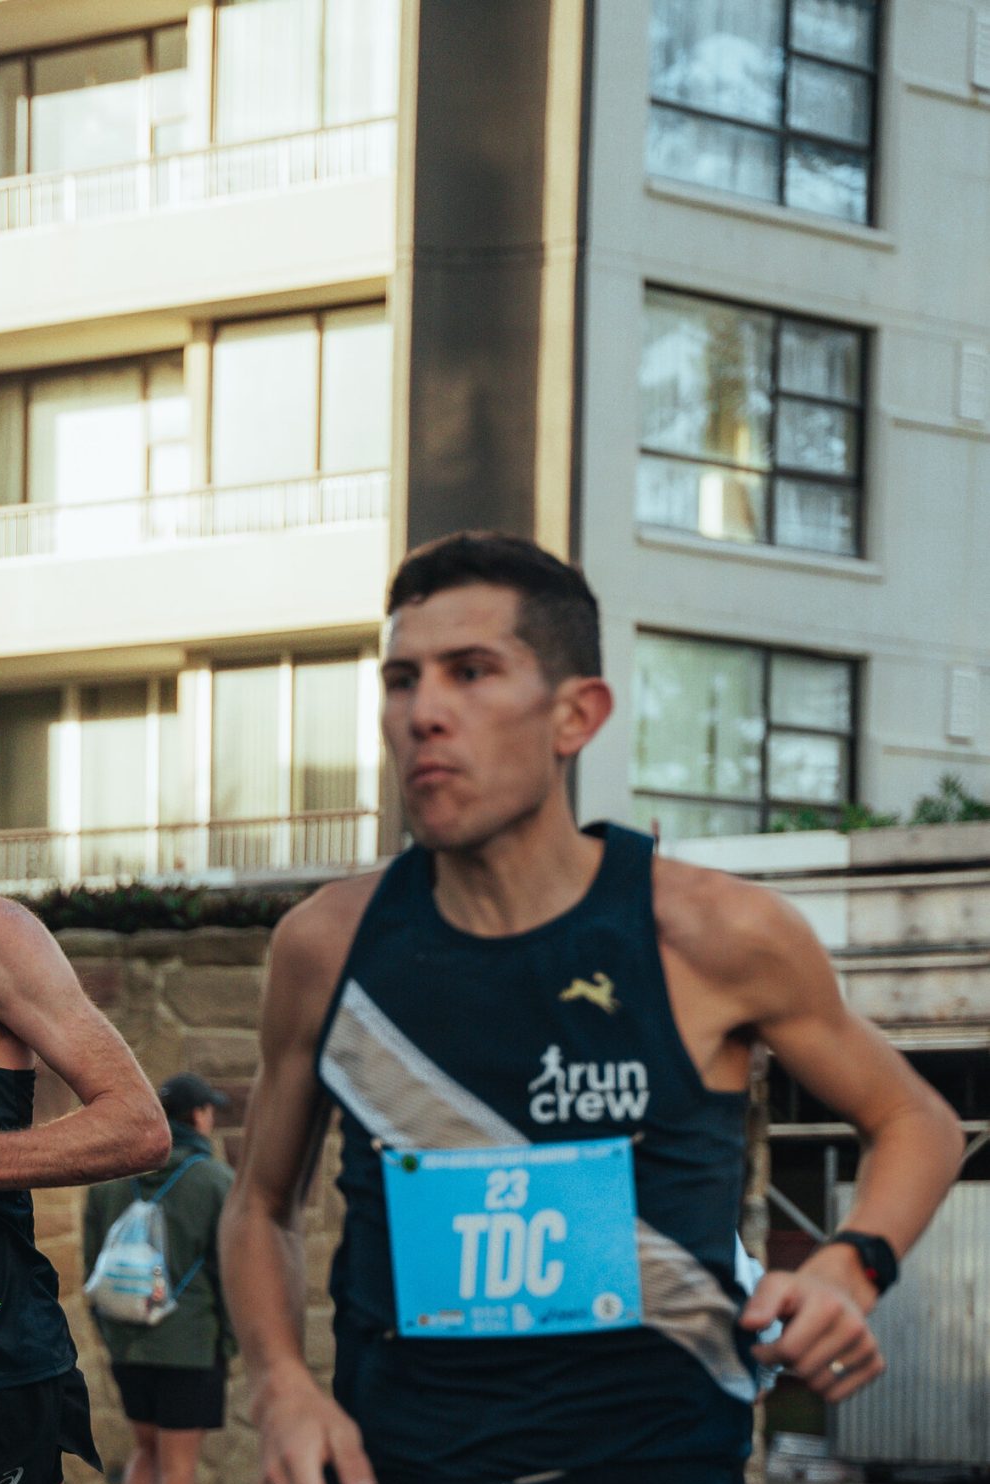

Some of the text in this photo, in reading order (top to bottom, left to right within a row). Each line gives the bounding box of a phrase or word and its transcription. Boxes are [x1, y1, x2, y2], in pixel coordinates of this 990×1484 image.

[568, 1060, 648, 1092] run
[529, 1090, 650, 1124] crew
[484, 1168, 530, 1210] 23
[452, 1208, 567, 1300] TDC
